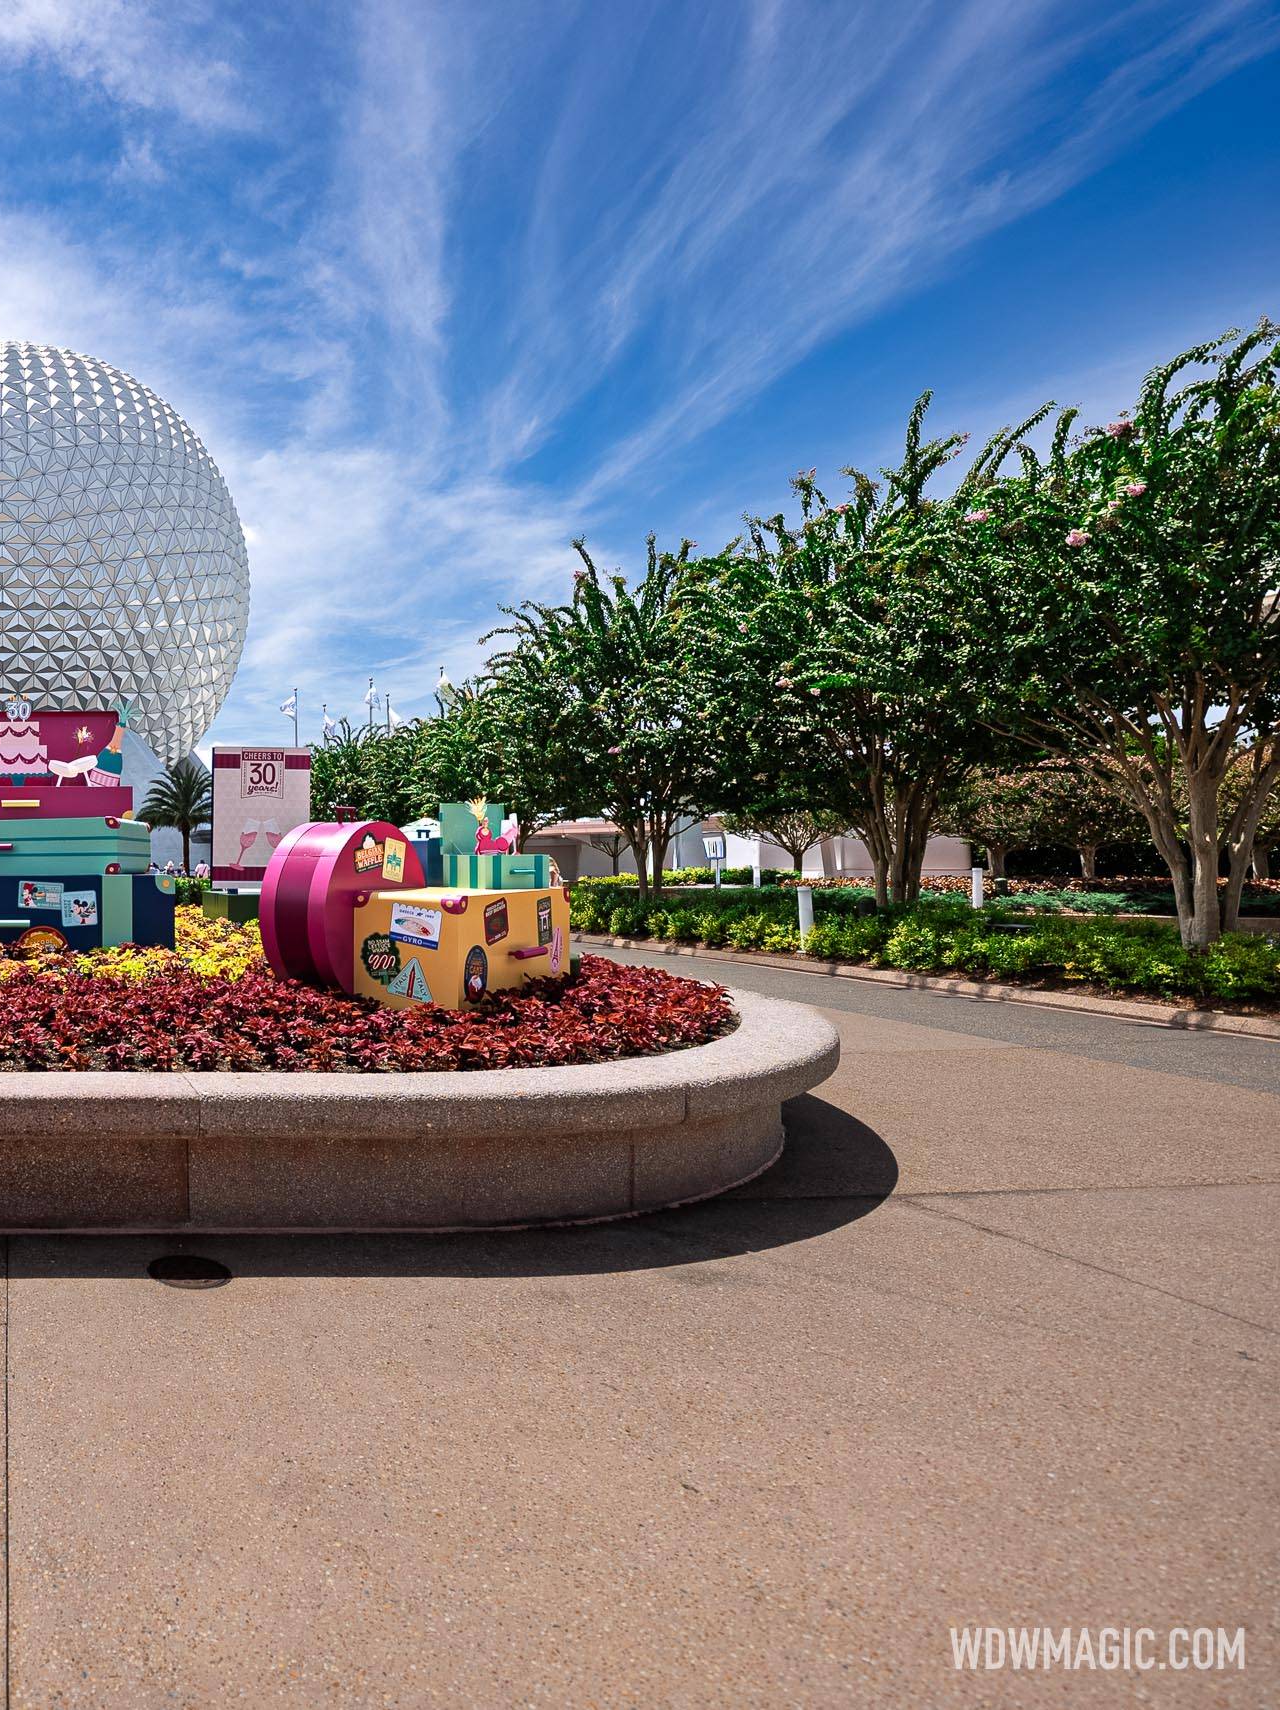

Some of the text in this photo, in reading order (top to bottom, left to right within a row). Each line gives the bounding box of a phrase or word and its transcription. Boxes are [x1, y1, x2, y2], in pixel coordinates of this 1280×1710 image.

[6, 701, 31, 720] 30
[243, 752, 282, 760] CHEERS TO
[249, 763, 276, 785] 30
[247, 782, 279, 795] years!
[357, 855, 383, 868] WAFFLE
[402, 936, 423, 945] GYRO
[393, 972, 409, 990] ITALY
[416, 977, 428, 997] ITALY
